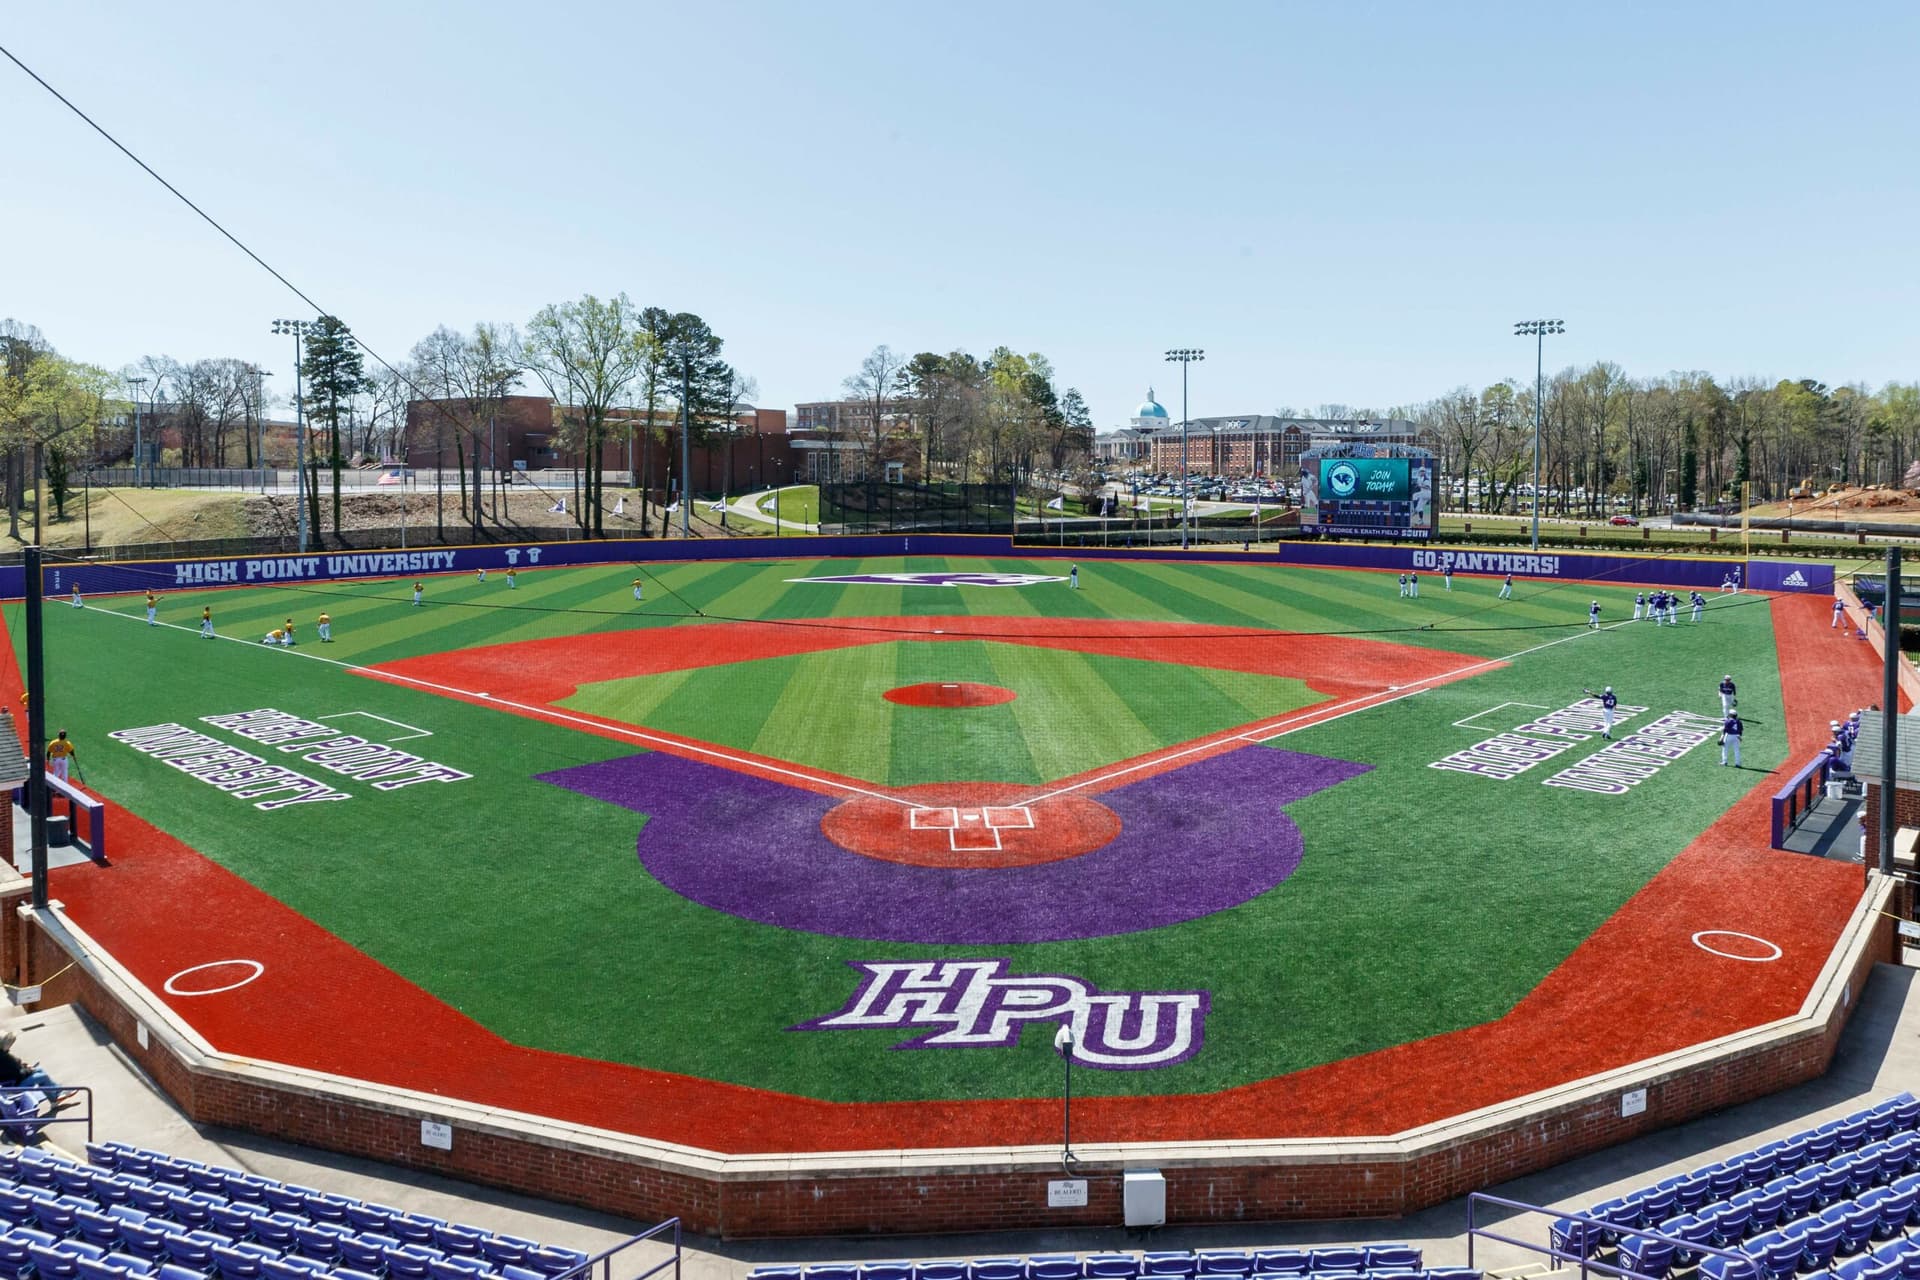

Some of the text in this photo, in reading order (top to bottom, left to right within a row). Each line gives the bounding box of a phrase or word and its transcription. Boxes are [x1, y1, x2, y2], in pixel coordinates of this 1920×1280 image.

[1366, 480, 1396, 493] TODAY!
[1370, 469, 1391, 480] JOIN
[1329, 527, 1353, 535] GEORGE
[1360, 528, 1381, 536] ERATH
[1381, 529, 1400, 537] FIELD
[1401, 529, 1429, 538] SOUTH
[175, 551, 456, 584] HIGH POINT UNIVERSITY
[1413, 550, 1560, 575] GO PANTHERS!
[1783, 579, 1808, 587] adidas
[198, 708, 474, 791] HIGH POINT
[1427, 732, 1577, 780] HIGH
[1541, 710, 1726, 795] UNIVERSITY
[107, 722, 353, 811] UNIVERSITY
[790, 957, 1211, 1070] HPU
